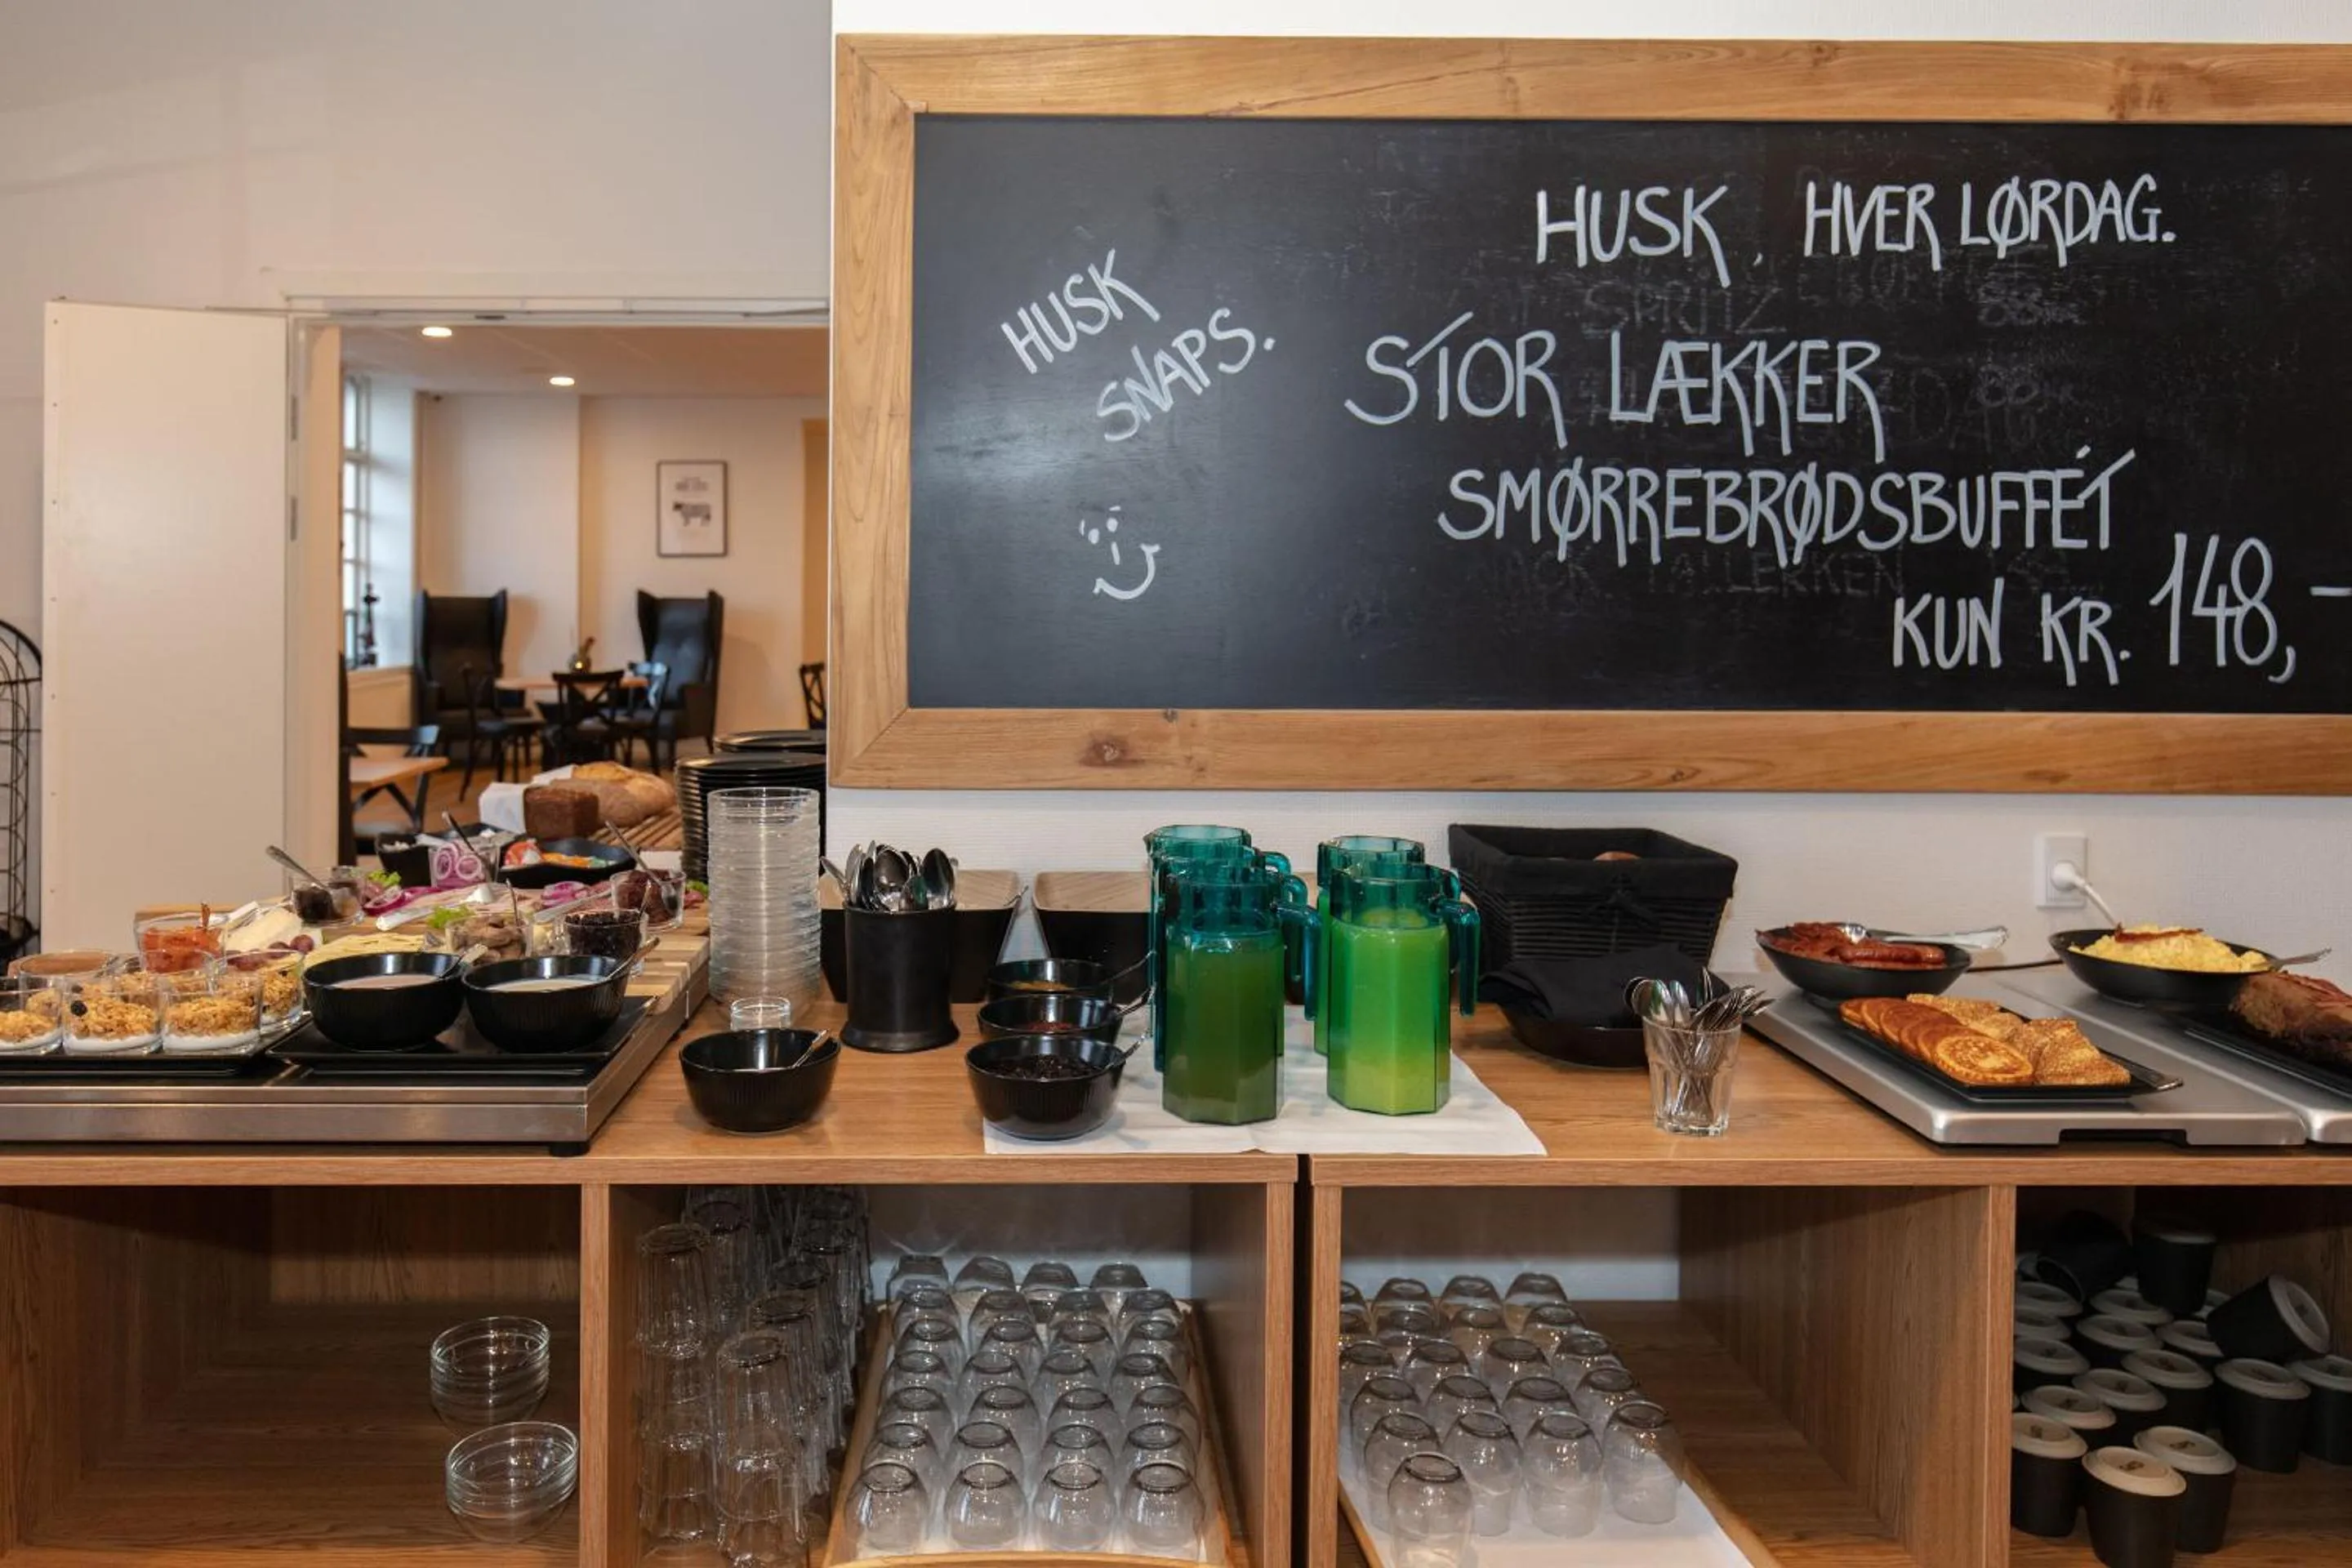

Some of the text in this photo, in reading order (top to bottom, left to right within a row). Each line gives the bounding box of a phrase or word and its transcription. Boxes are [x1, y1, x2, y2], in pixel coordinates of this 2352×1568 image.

[1803, 180, 1941, 271] HVER
[1959, 173, 2176, 267] LØRDAG.
[1000, 248, 1160, 374] HUSK
[1095, 306, 1276, 442] SNAPS.
[1343, 310, 1568, 450] STOR
[1608, 329, 1885, 464] LÆKKER
[1893, 577, 2005, 669] KUN
[2040, 593, 2131, 686] KR.
